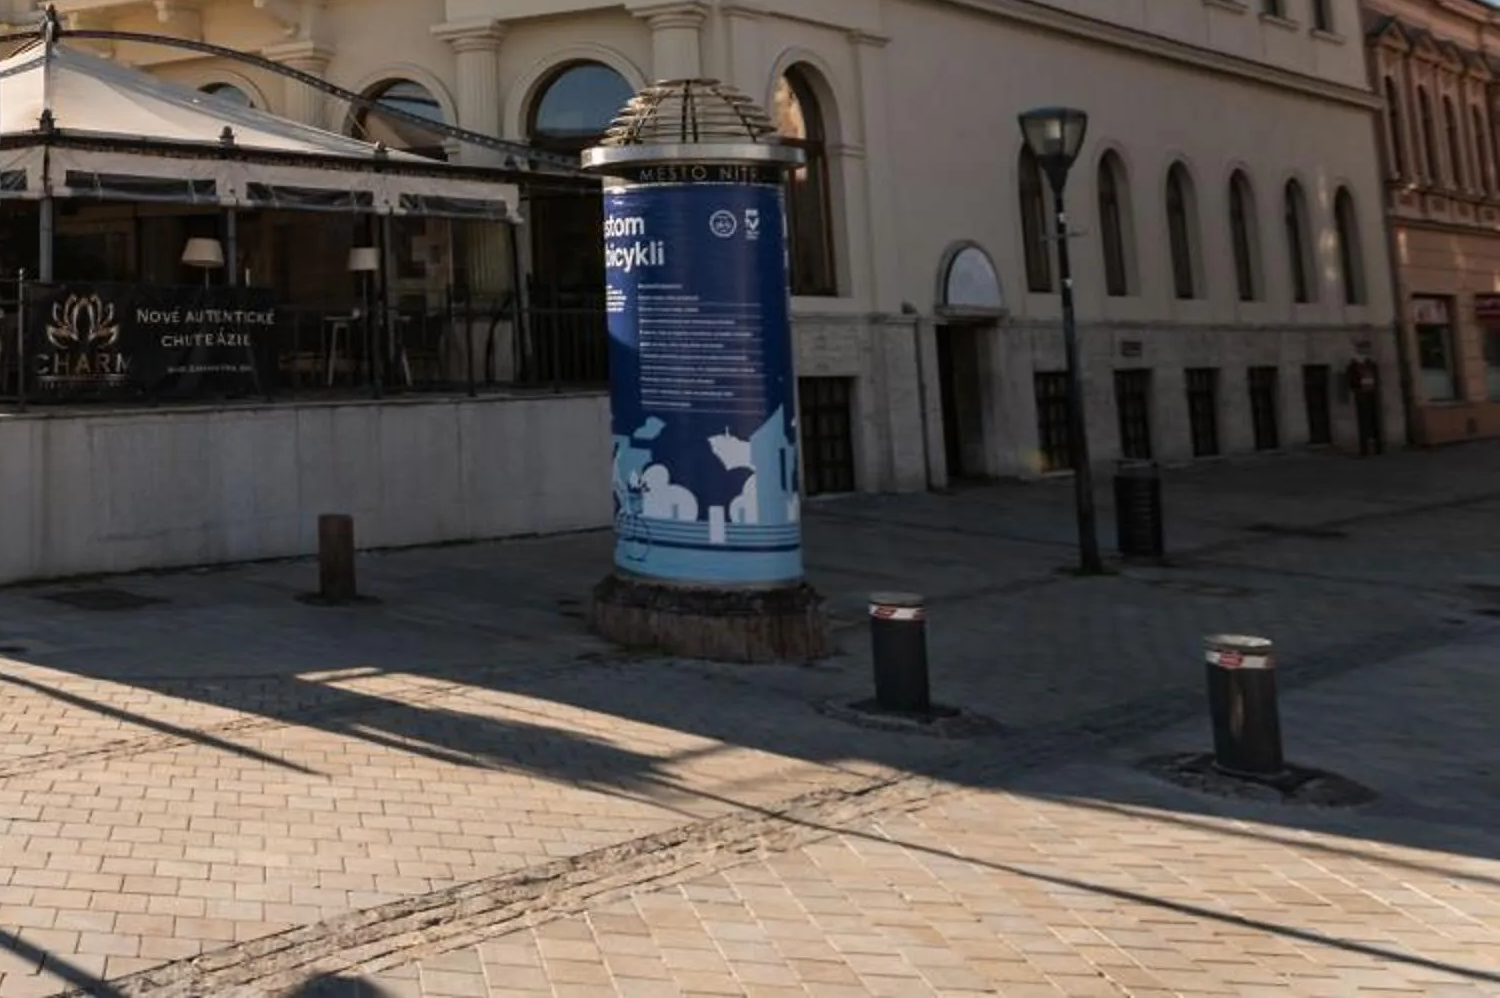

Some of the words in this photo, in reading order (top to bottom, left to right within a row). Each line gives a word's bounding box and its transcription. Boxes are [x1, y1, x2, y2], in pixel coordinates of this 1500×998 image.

[639, 165, 707, 182] MESTO
[136, 306, 180, 324] NOVÉ
[185, 307, 276, 325] AUTENTICKÉ
[161, 333, 214, 348] CHUTE
